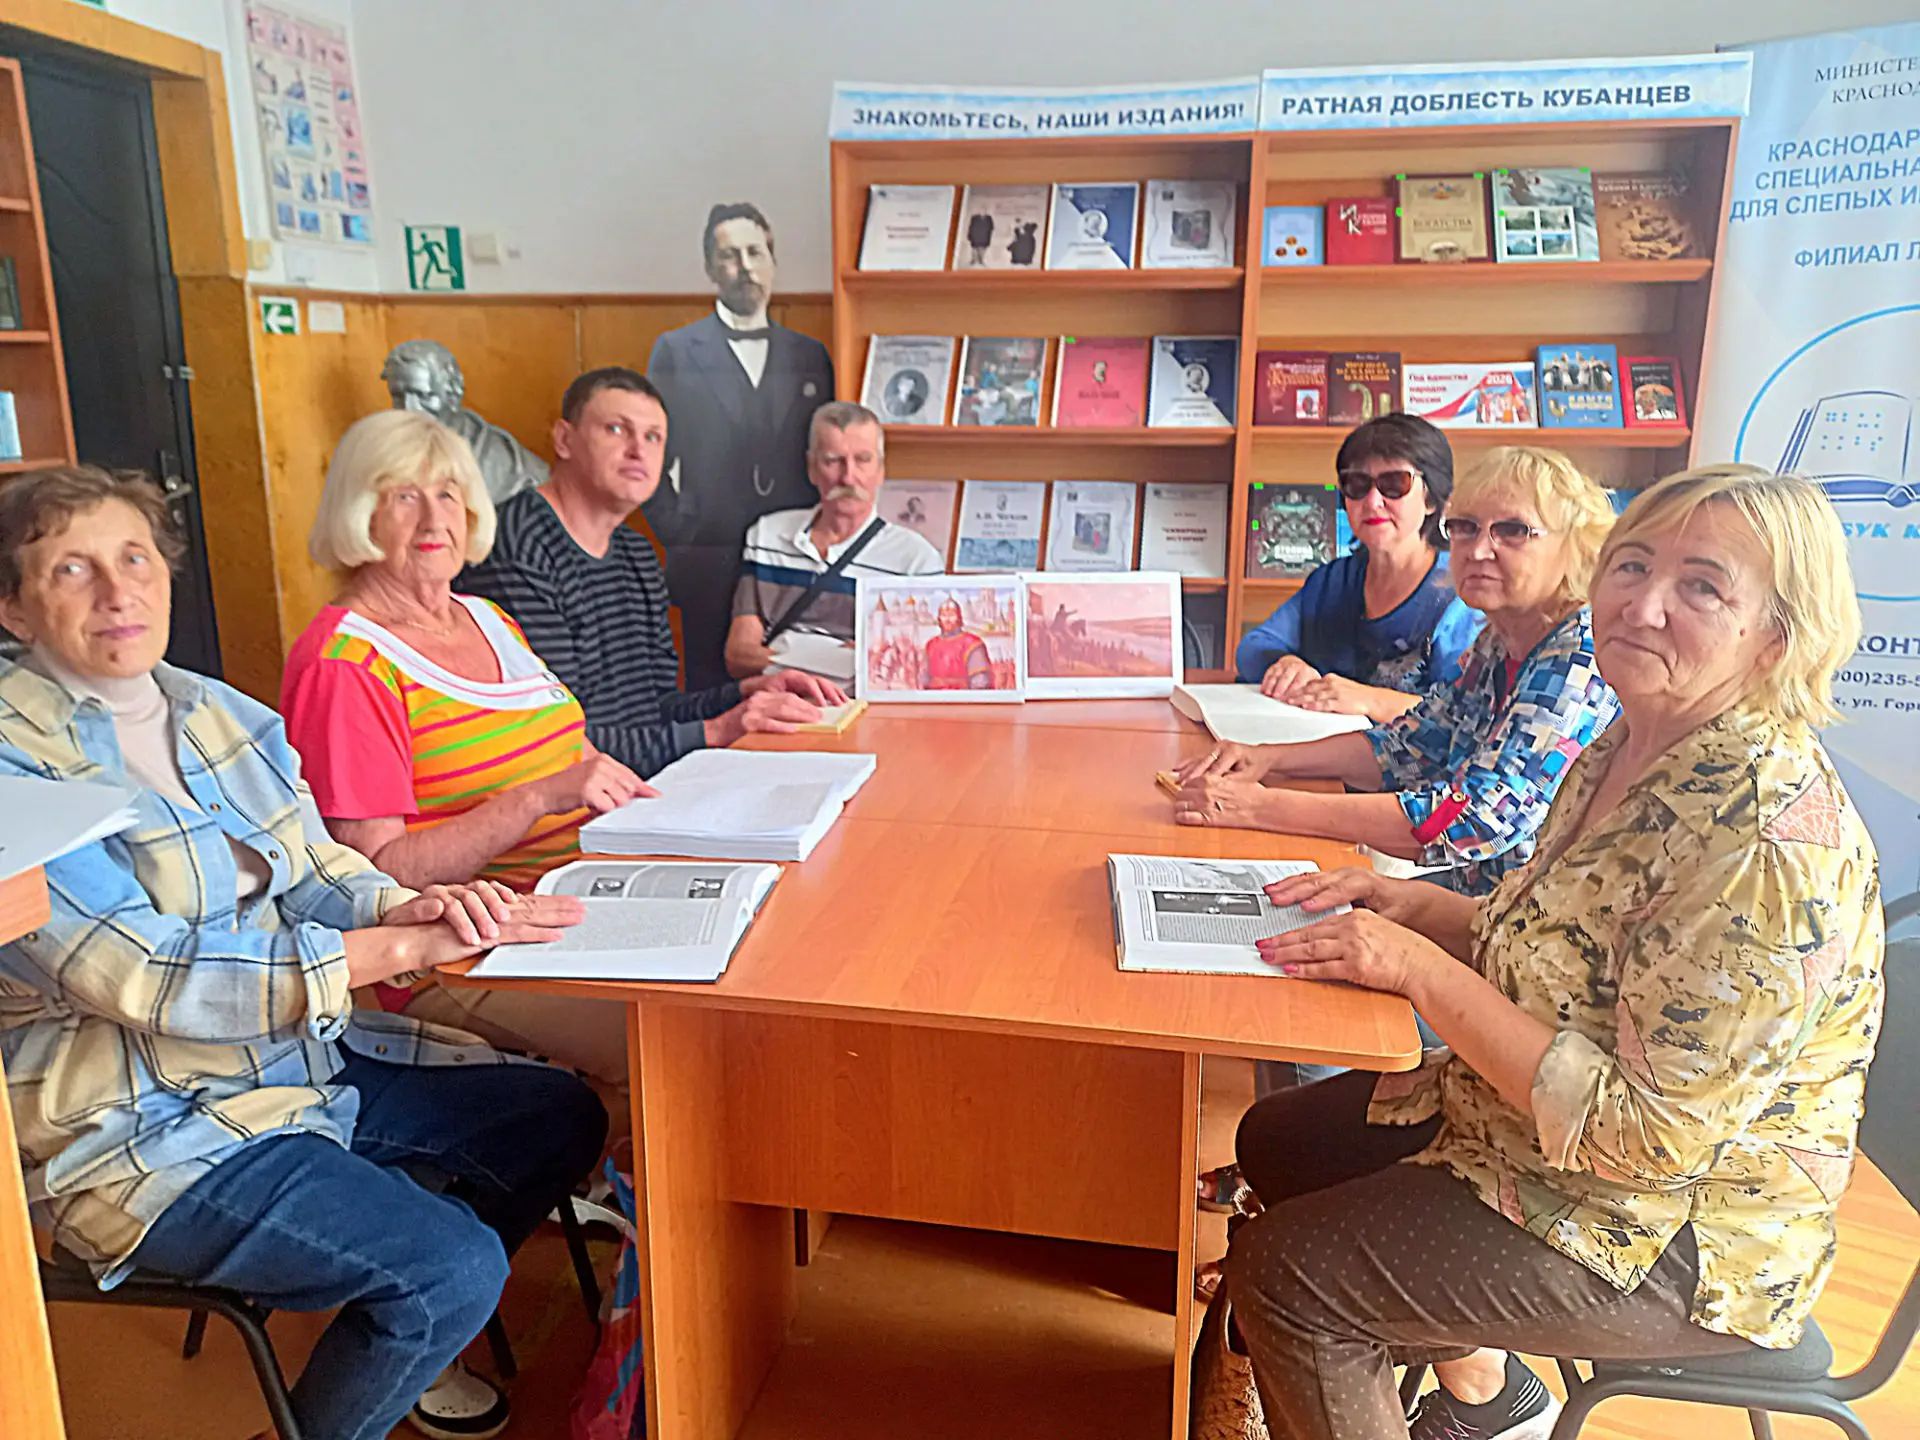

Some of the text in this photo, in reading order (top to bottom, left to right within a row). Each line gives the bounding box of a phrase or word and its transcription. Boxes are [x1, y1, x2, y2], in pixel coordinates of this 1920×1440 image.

[1282, 85, 1692, 117] РАТНАЯ ДОБЛЕСТЬ КУБАНЦЕВ
[853, 102, 1246, 132] ЗНАКОМЬТЕСЬ, НАШИ ИЗДАНИЯ!
[1768, 129, 1920, 162] КРАСНОДАР
[1730, 198, 1778, 222] ДЛЯ
[1785, 188, 1892, 215] СЛЕПЫХ
[1794, 242, 1899, 268] ФИЛИАЛ
[1852, 697, 1878, 709] ул.
